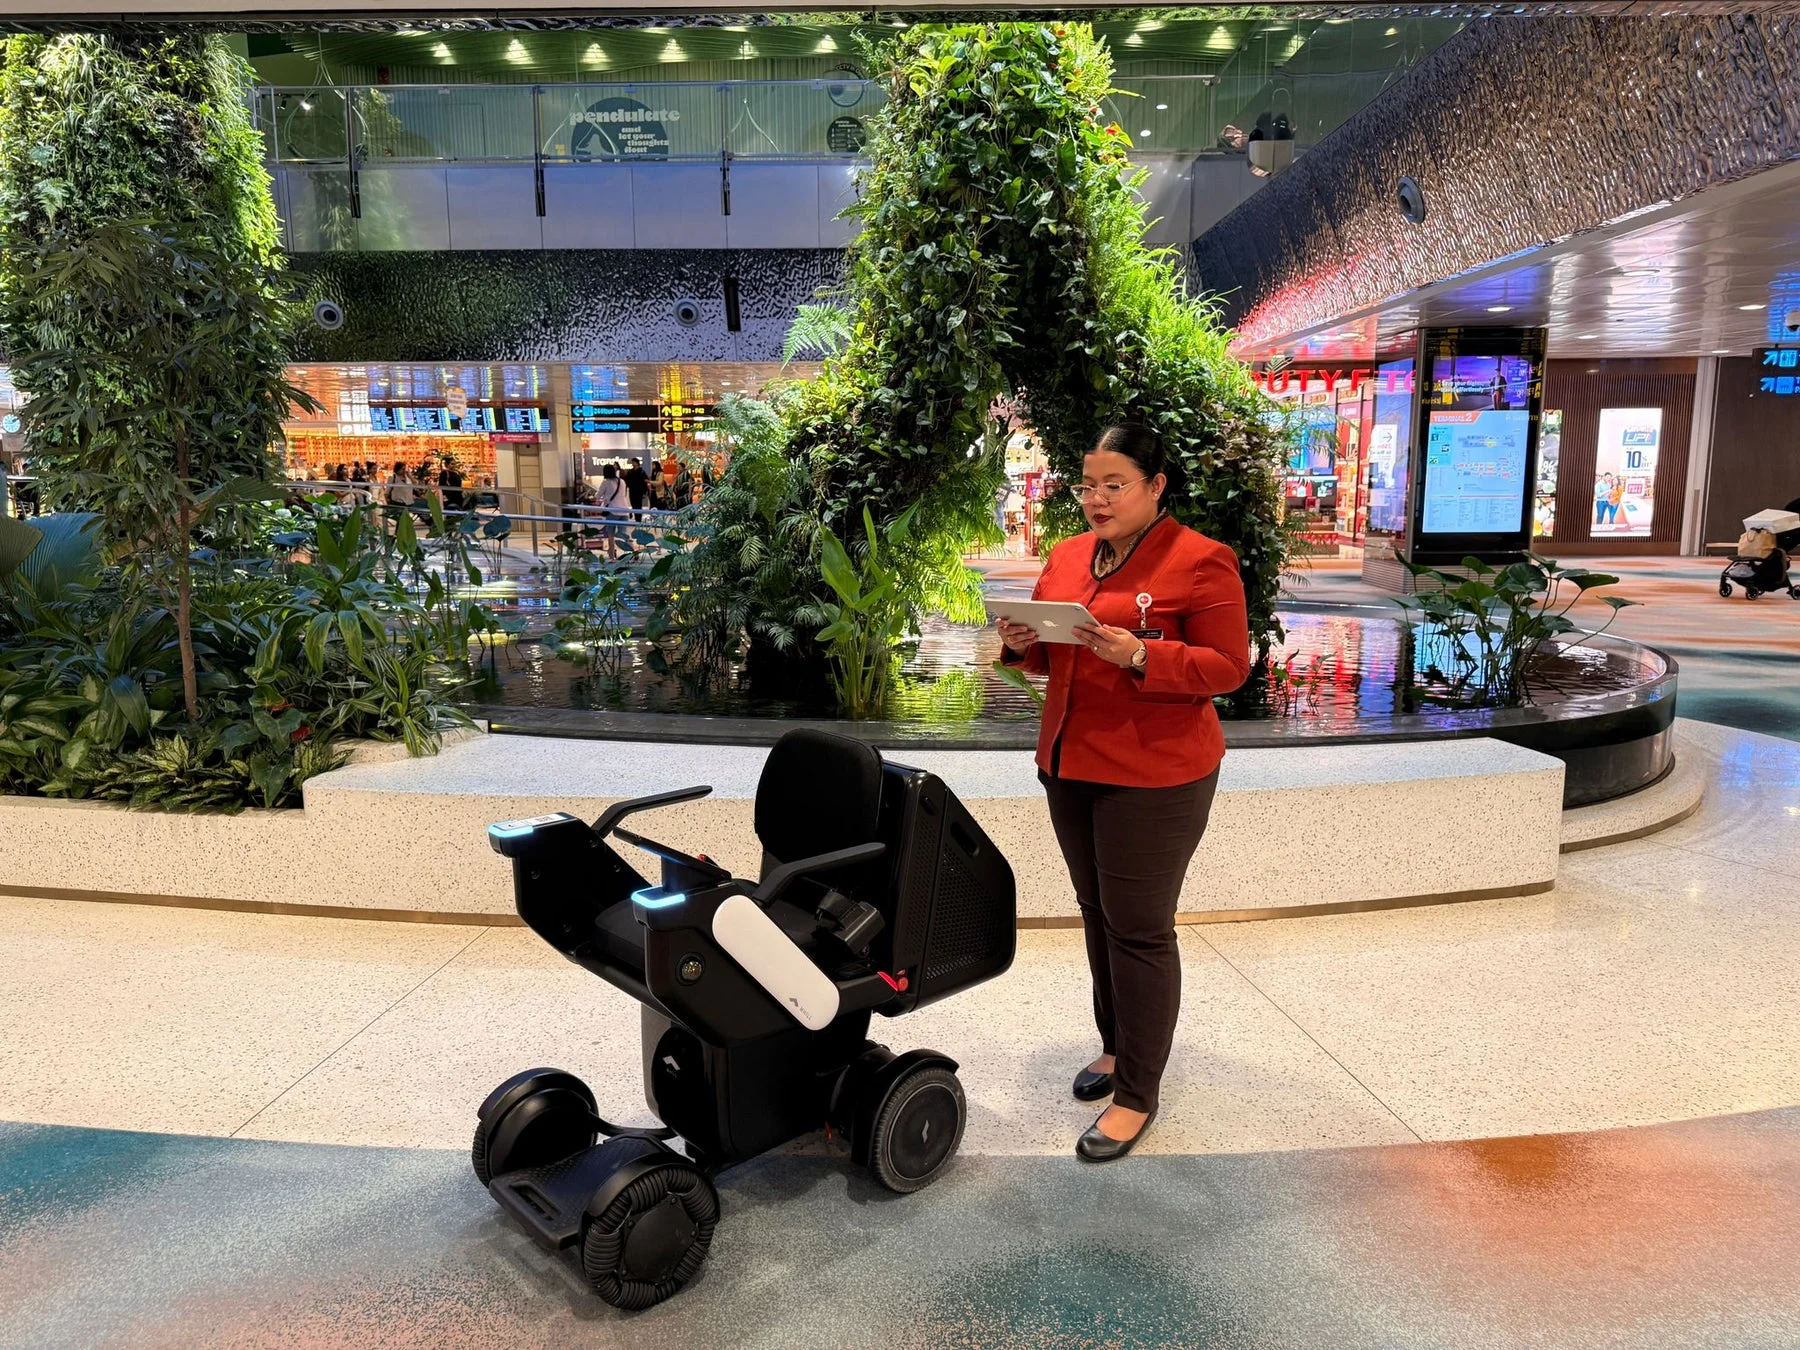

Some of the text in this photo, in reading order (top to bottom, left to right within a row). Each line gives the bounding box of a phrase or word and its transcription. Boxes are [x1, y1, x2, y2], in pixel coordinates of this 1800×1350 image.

[570, 109, 680, 126] pendulate
[1433, 411, 1473, 422] TERMINAL 2
[1626, 450, 1642, 468] 10
